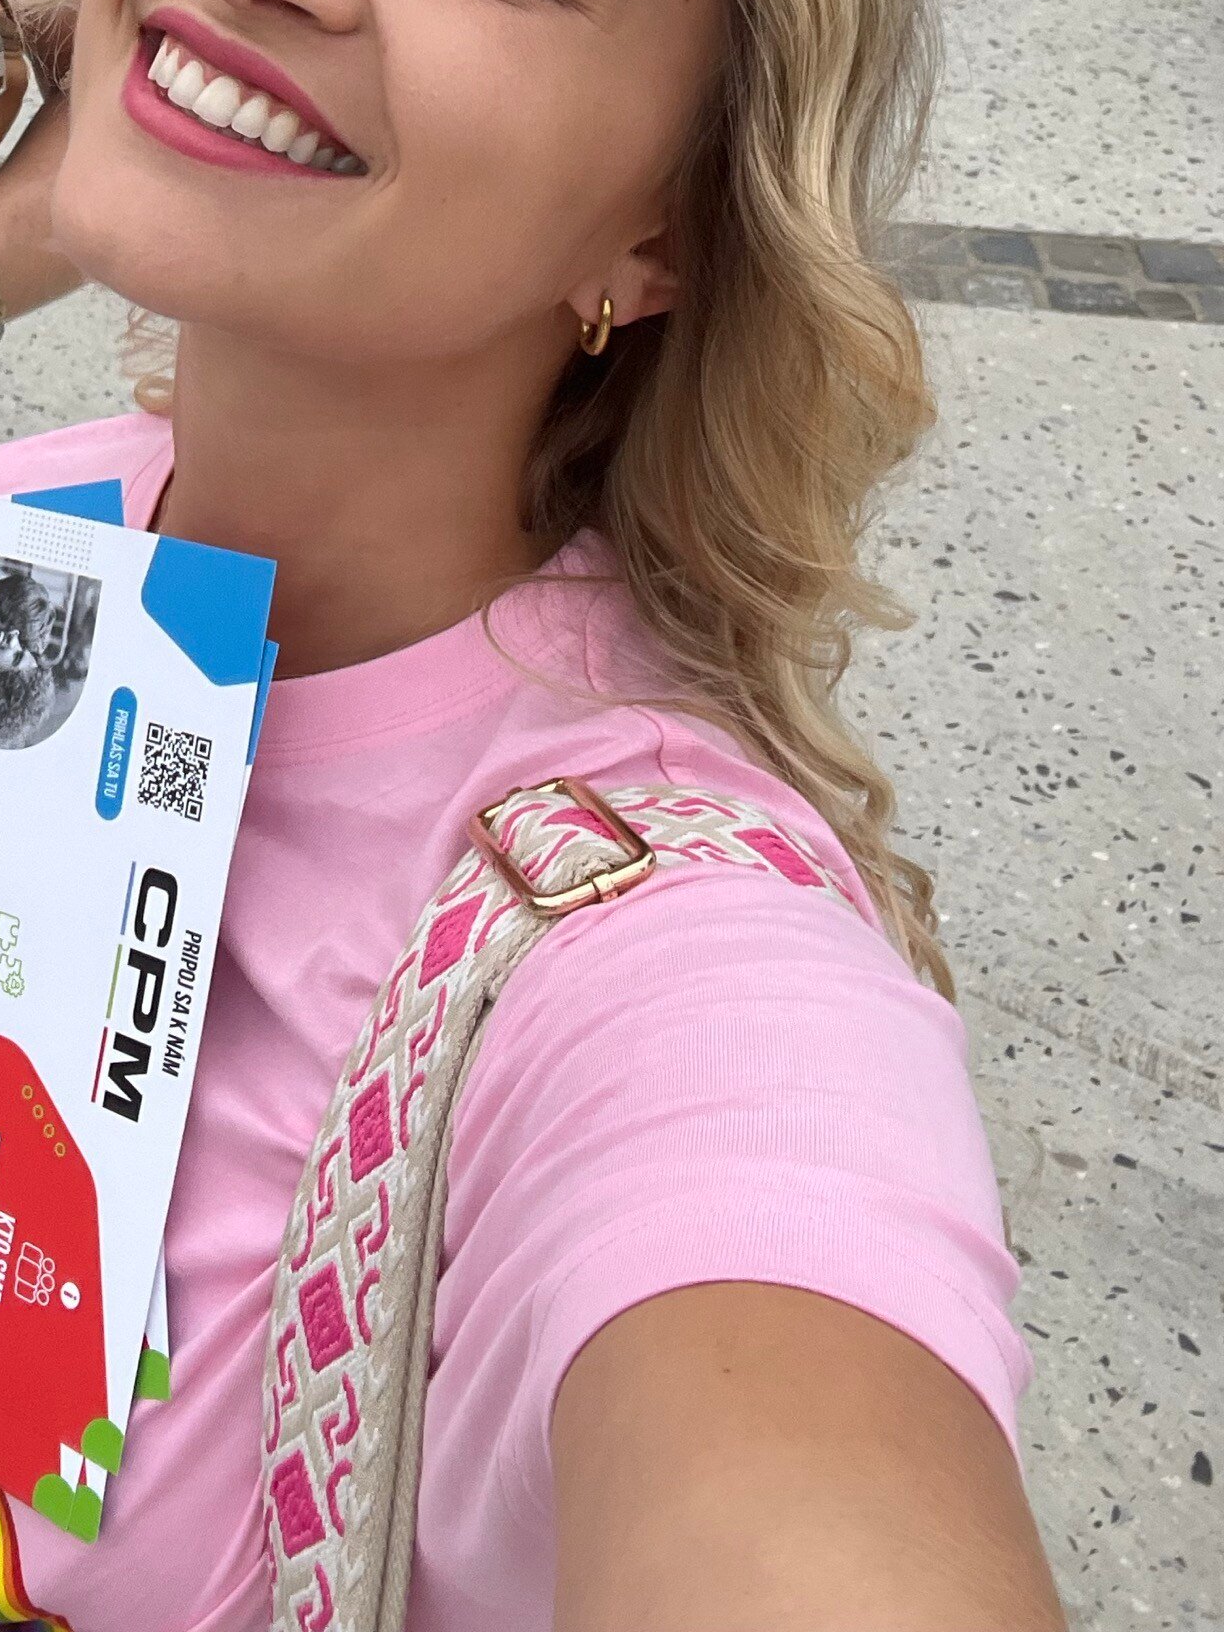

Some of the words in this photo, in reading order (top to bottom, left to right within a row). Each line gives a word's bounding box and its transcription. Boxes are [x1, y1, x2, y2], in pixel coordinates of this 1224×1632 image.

[109, 708, 129, 761] PRIHLÁS
[106, 761, 121, 779] SA
[103, 781, 118, 798] TU
[177, 929, 202, 990] PRIPOJ
[104, 869, 177, 1119] CPM
[172, 990, 192, 1015] SA
[168, 1017, 188, 1034] K
[162, 1033, 185, 1077] NÁM
